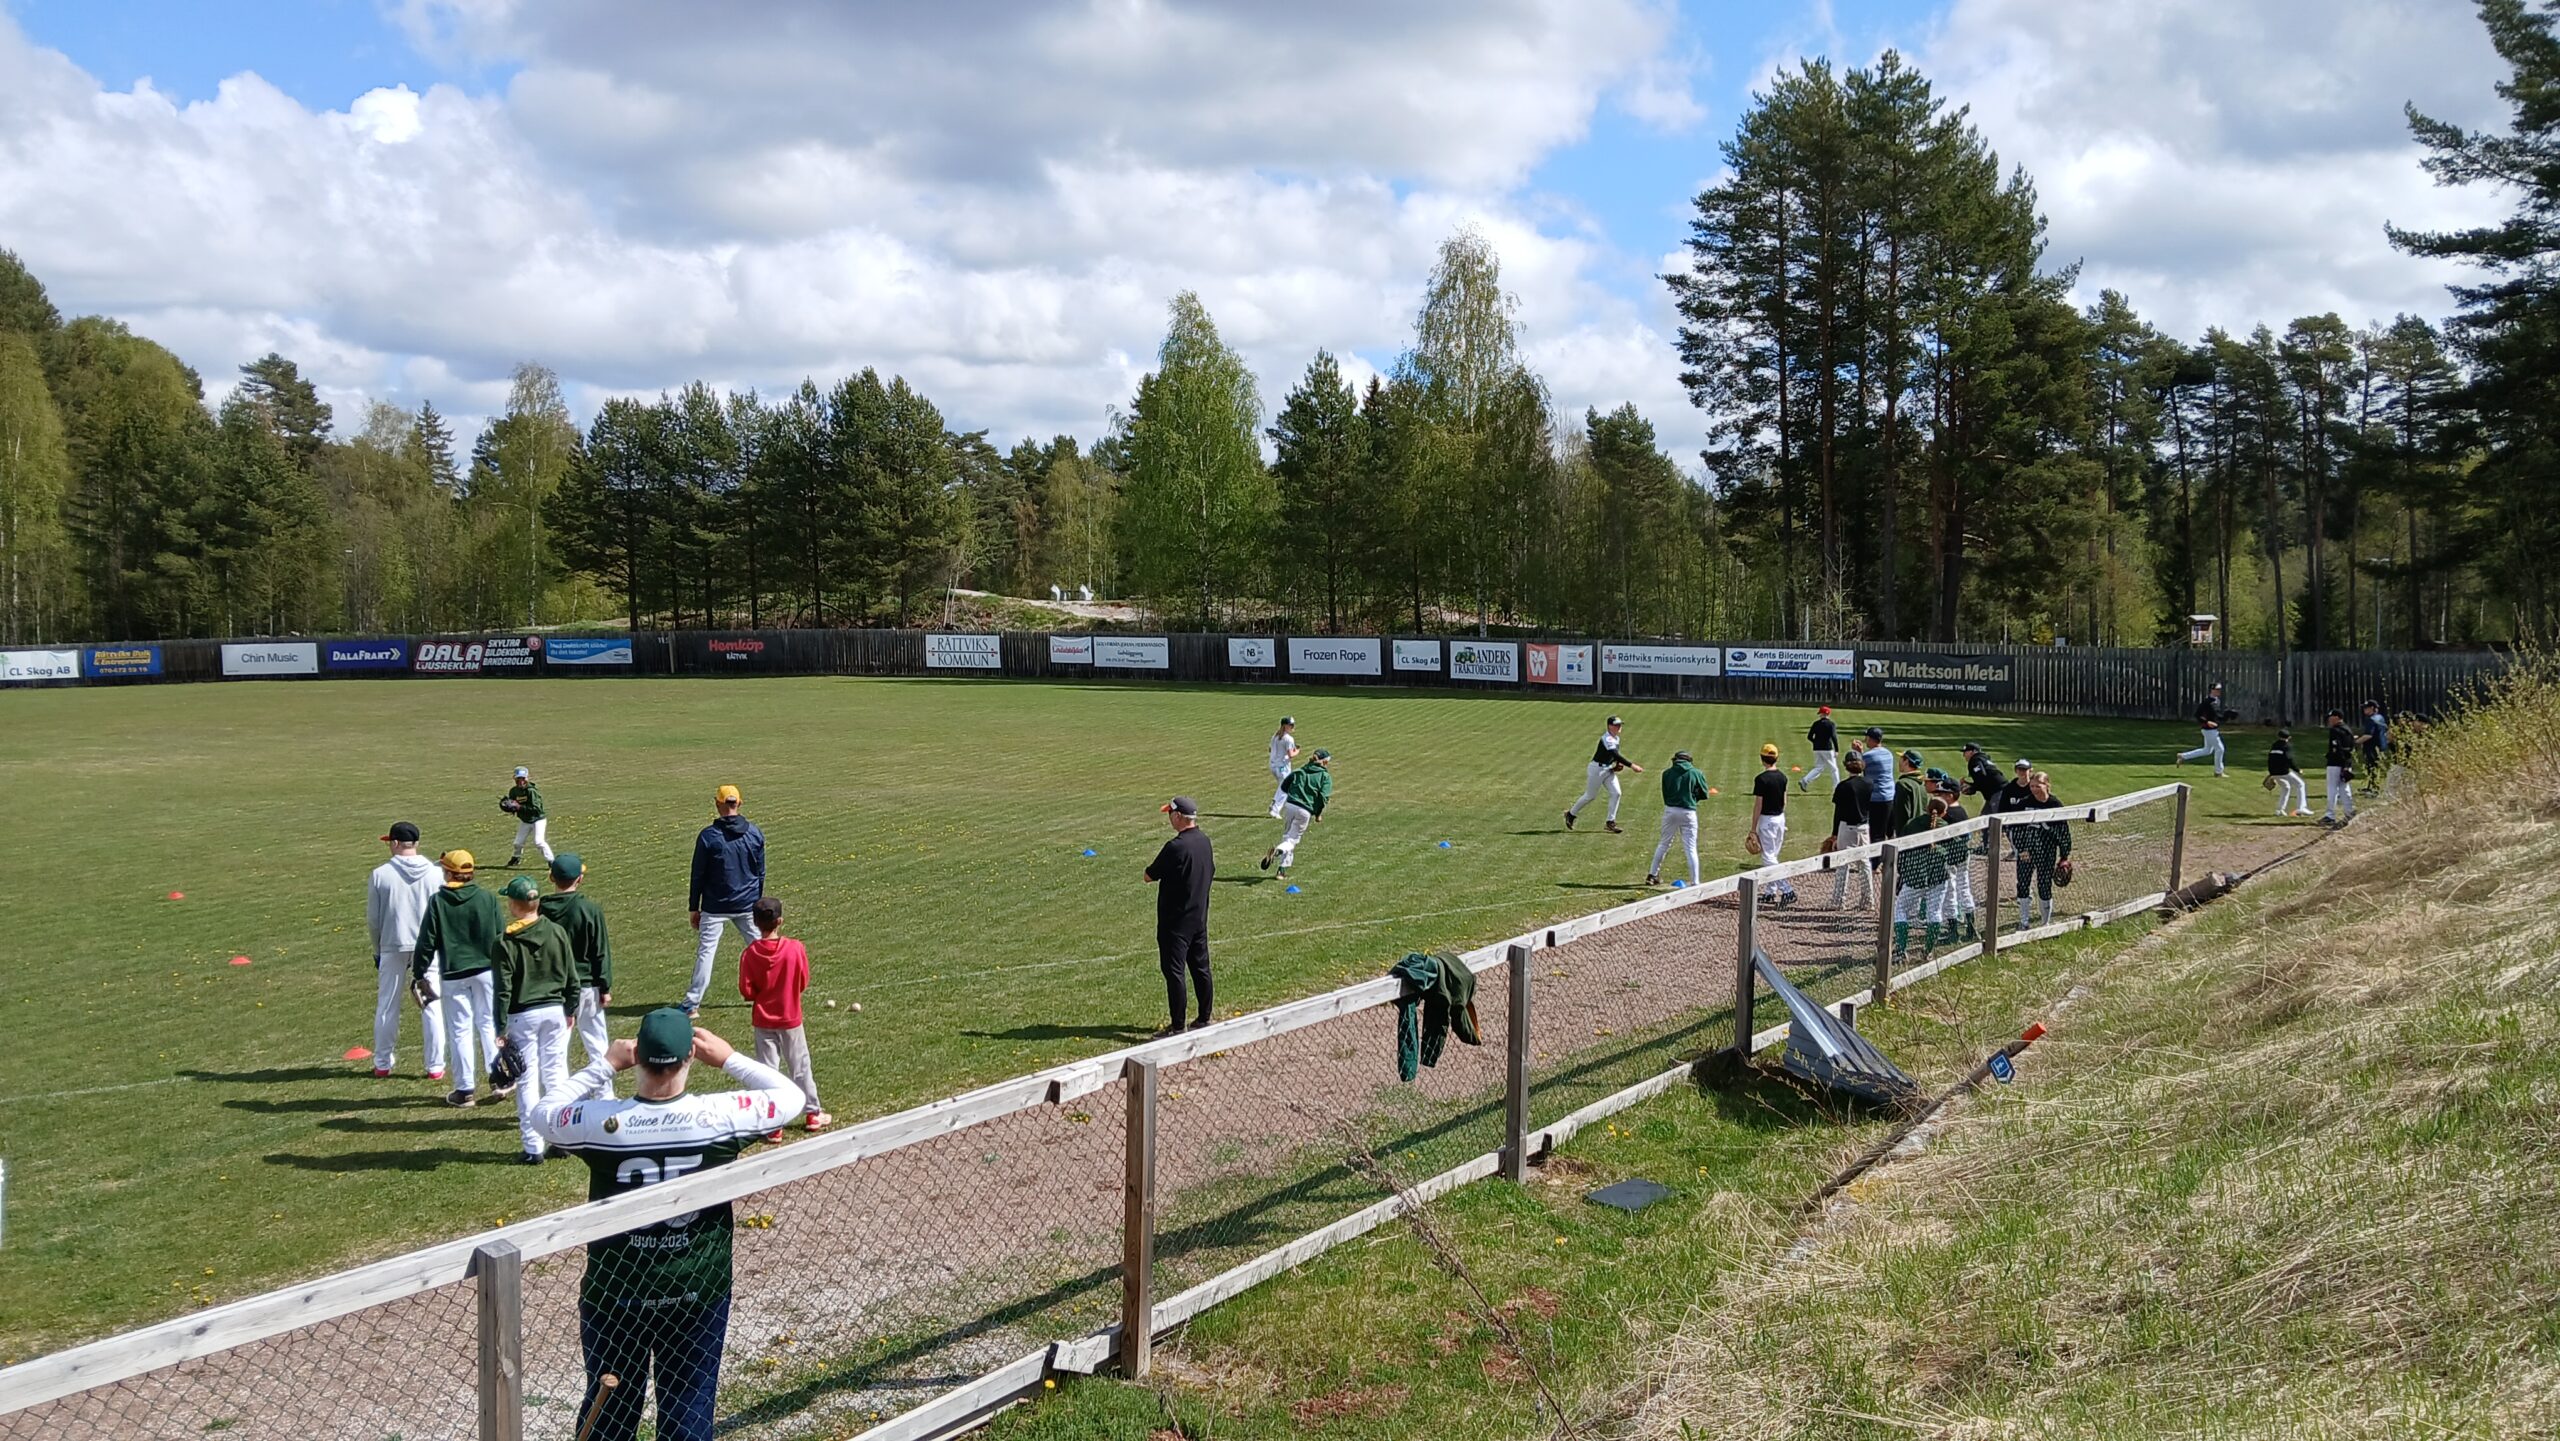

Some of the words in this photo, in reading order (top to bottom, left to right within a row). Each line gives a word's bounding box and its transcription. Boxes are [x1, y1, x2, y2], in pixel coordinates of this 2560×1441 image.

[487, 638, 521, 647] SKYLTAR
[709, 639, 764, 652] Hemköp
[937, 636, 989, 651] RÄTTVIKS
[241, 653, 265, 663] Chin
[267, 652, 298, 663] Music
[418, 644, 483, 661] DALA
[484, 647, 530, 656] BILDEKORER
[1303, 649, 1337, 661] Frozen
[1339, 650, 1367, 663] Rope
[1476, 649, 1511, 664] ANDERS
[1753, 651, 1776, 659] Kents
[1778, 651, 1823, 660] Bilcentrum
[416, 660, 480, 670] LJUSREKLAM
[482, 657, 534, 666] BANDEROLLER
[937, 653, 990, 667] KOMMUN
[1401, 656, 1410, 664] CL
[1411, 656, 1428, 666] Skog
[1618, 652, 1651, 663] Rättviks
[1654, 653, 1716, 665] missionskyrka
[9, 667, 22, 676] CL
[26, 667, 52, 677] Skog
[56, 666, 71, 675] AB
[1454, 663, 1511, 676] TRAKTORSERVICE
[1893, 661, 1962, 679] Mattsson
[1964, 663, 2009, 681] Metal
[624, 1115, 659, 1128] Since
[661, 1111, 693, 1125] 1990
